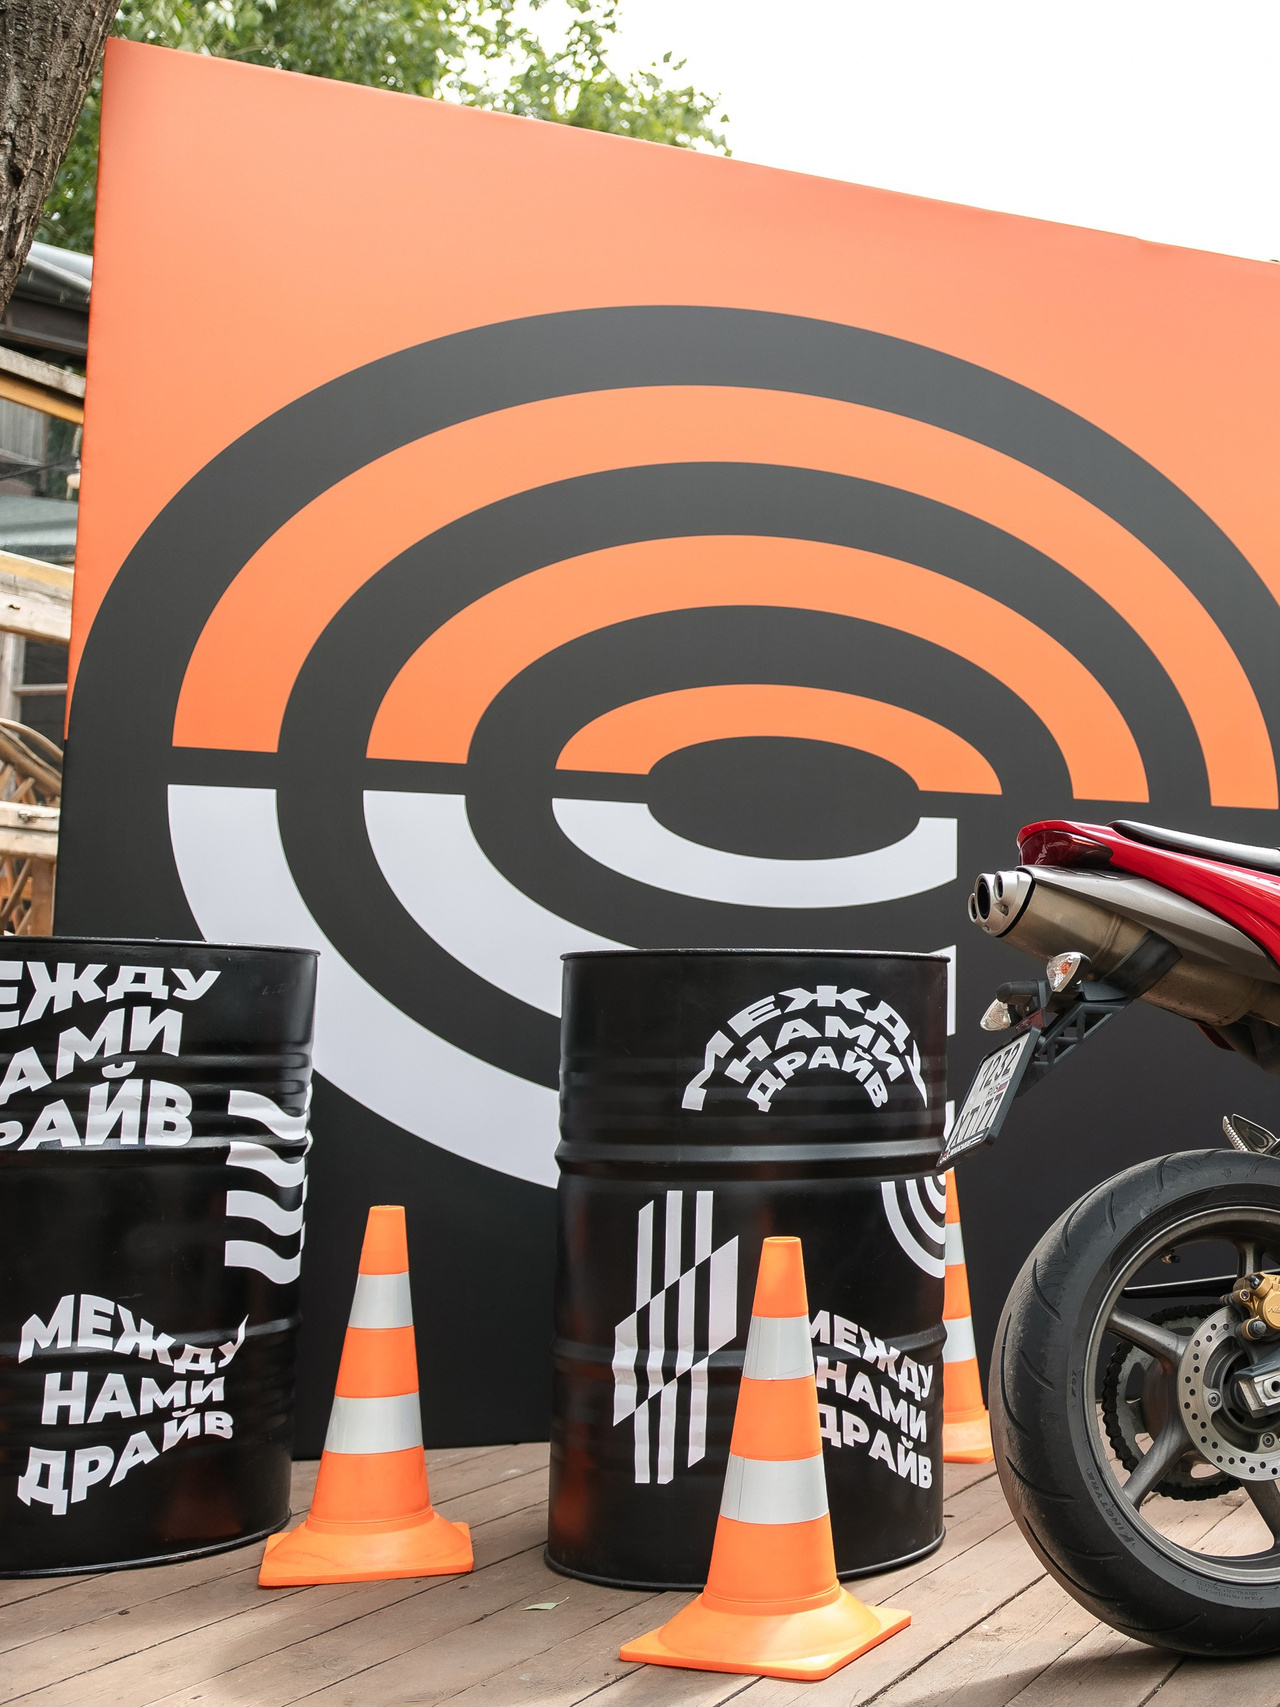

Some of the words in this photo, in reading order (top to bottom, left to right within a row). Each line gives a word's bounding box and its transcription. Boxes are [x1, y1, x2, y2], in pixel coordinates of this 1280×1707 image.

[0, 1006, 183, 1105] АМИ
[724, 1015, 905, 1085] НАМИ
[747, 1046, 889, 1113] ДРАЙВ
[979, 1042, 1021, 1092] 1232
[18, 1294, 249, 1374] МЕЖДУ
[41, 1371, 225, 1425] НАМИ
[816, 1355, 927, 1443] НАМИ
[17, 1408, 234, 1515] ДРАЙВ
[818, 1404, 933, 1489] ДРАЙВ
